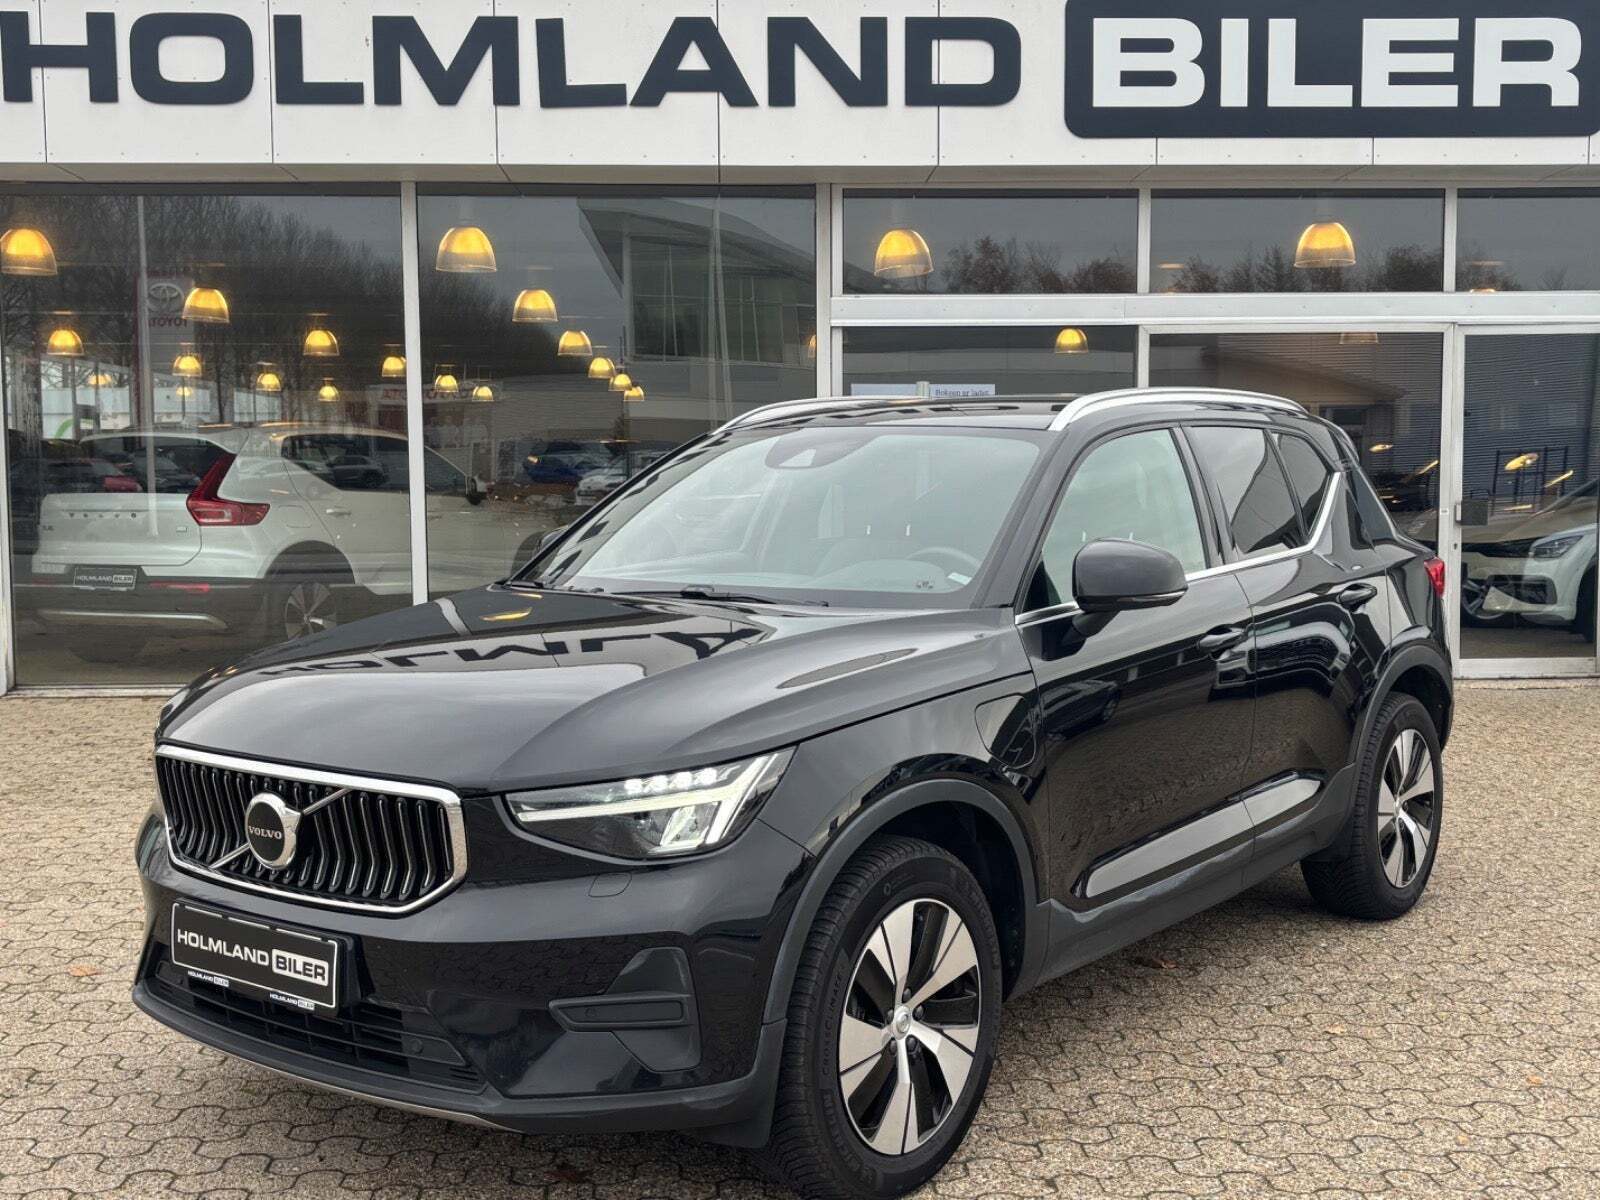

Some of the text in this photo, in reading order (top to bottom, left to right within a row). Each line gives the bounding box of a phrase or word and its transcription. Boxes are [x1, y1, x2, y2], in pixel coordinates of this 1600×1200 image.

[0, 11, 1581, 107] HOLMLAND BILER
[248, 826, 282, 839] VOLVO
[177, 929, 325, 981] HOLMLAND BILER
[188, 970, 213, 982] HOLMLAND
[269, 993, 297, 1005] HOLMLAND
